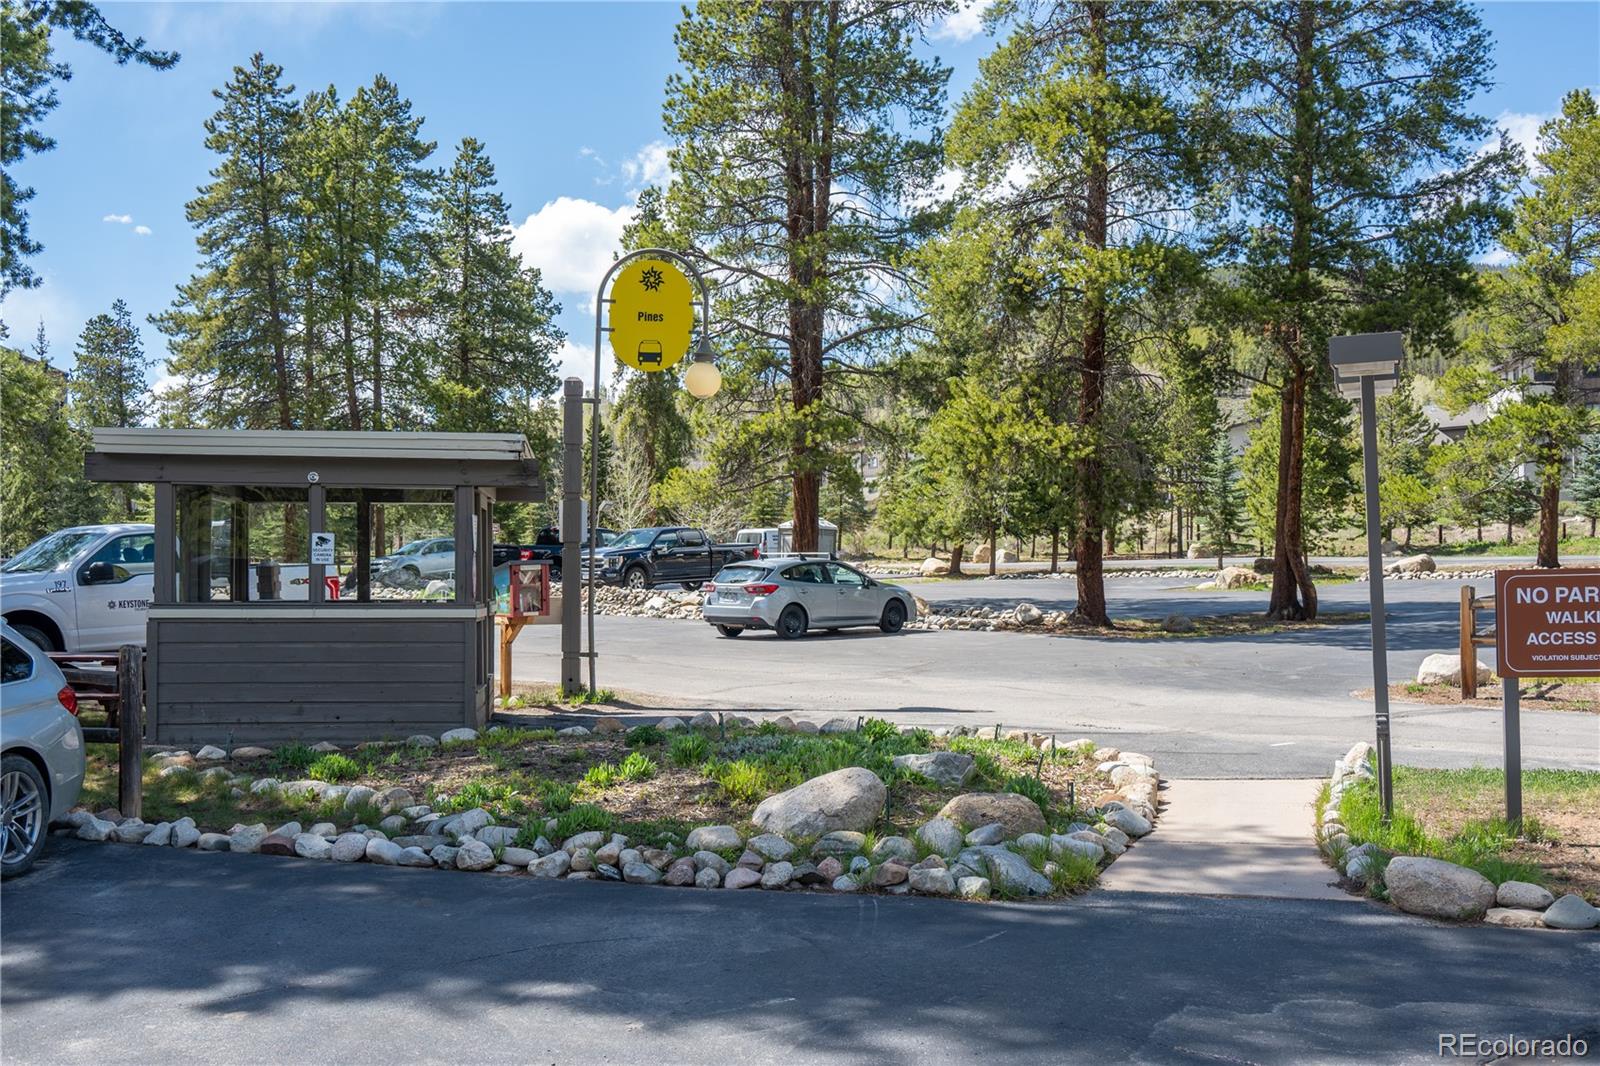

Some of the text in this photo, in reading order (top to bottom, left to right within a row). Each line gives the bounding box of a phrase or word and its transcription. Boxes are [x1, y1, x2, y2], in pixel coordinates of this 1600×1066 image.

[637, 311, 664, 322] Pines
[1516, 587, 1549, 604] NO
[118, 600, 149, 608] KEYSTONE
[1526, 632, 1597, 645] ACCESS
